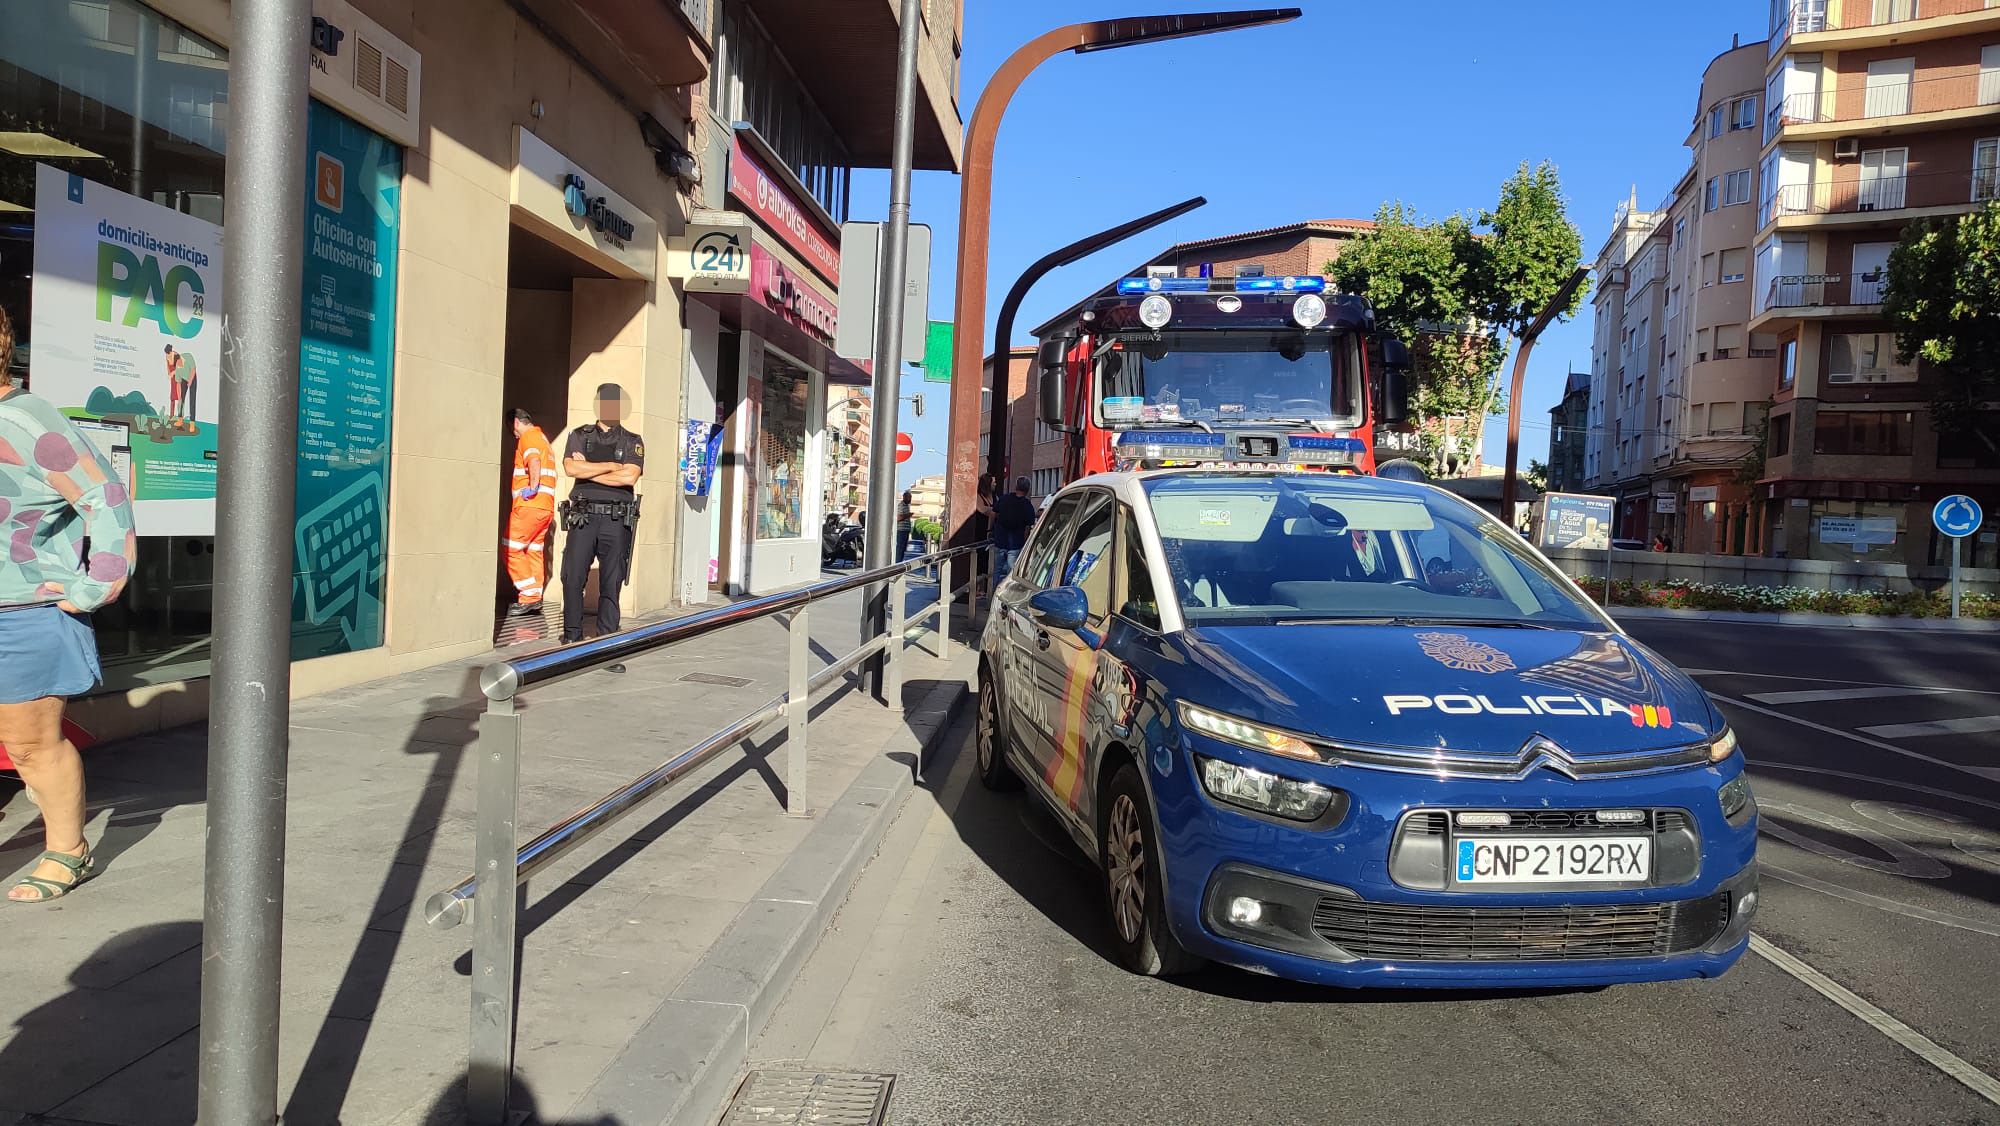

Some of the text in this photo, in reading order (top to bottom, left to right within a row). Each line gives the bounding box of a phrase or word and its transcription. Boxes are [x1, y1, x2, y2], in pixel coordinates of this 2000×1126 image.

[311, 54, 329, 75] RAL
[98, 219, 209, 268] domicilia+anticipa
[313, 213, 377, 257] Oficina con
[312, 236, 383, 278] Autoservicio
[96, 239, 205, 339] PAC
[1121, 334, 1162, 342] SIERRA 2
[1382, 693, 1641, 717] POLICÍA
[1463, 843, 1643, 876] E CNP2192RX
